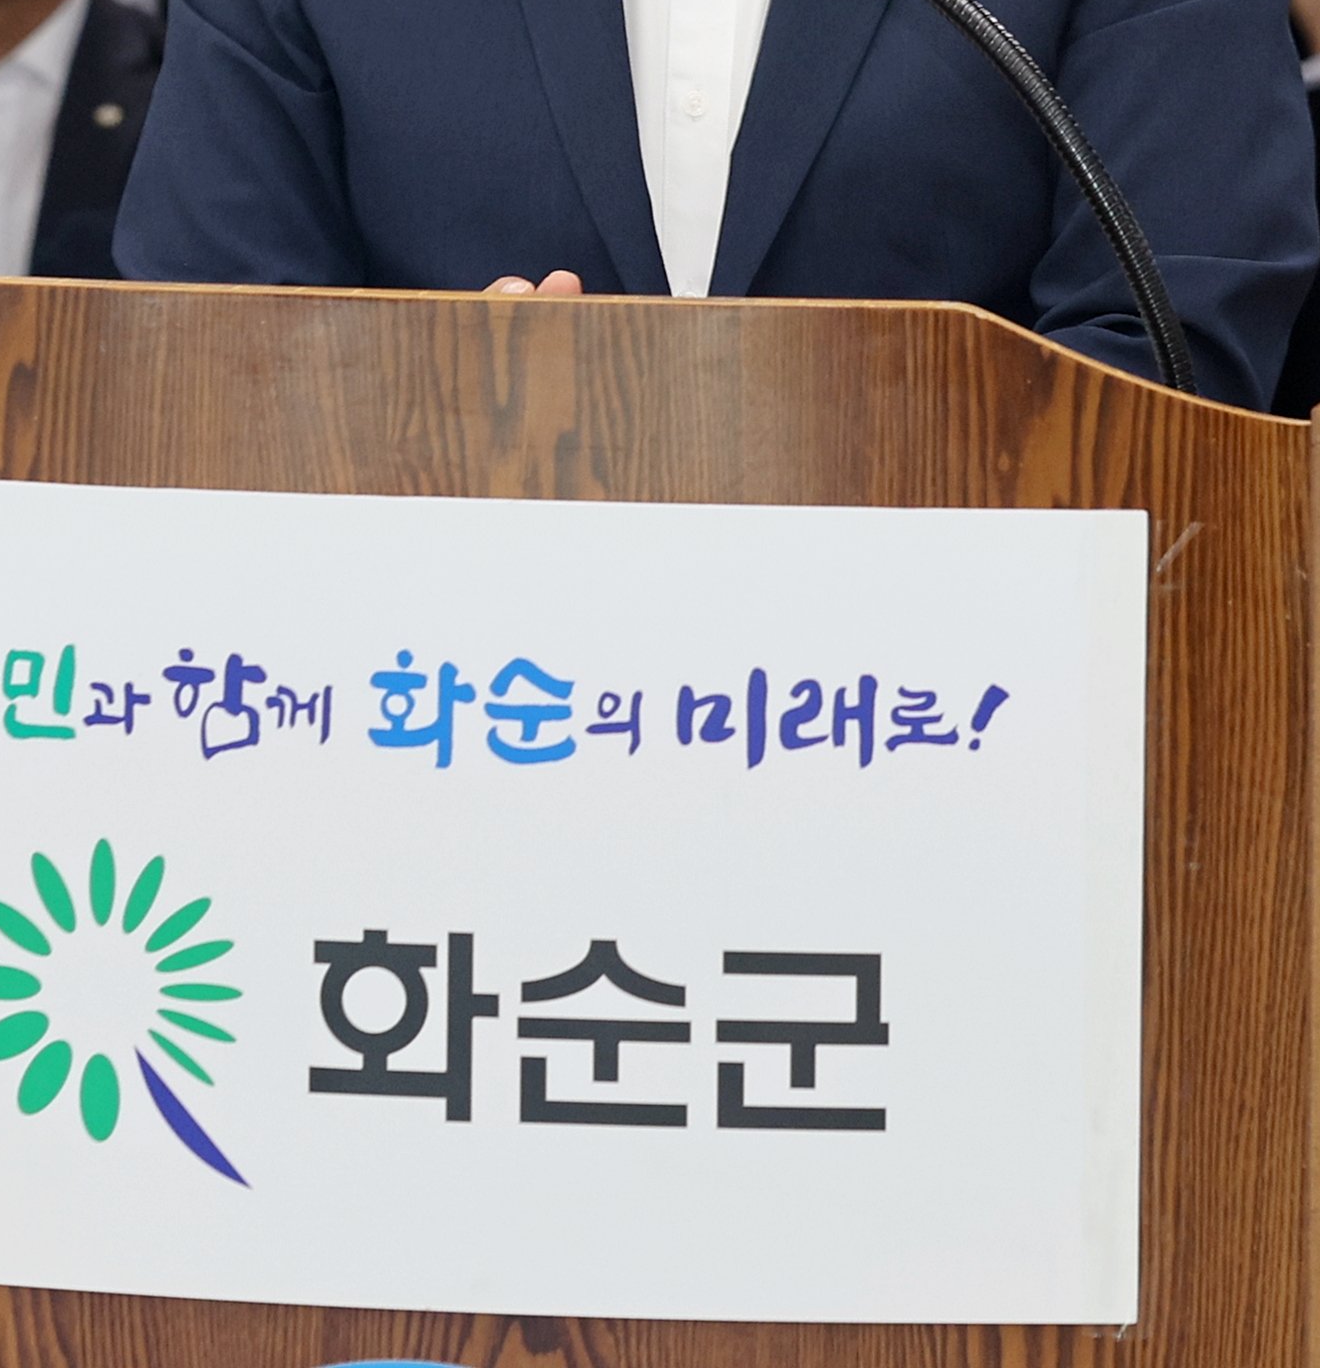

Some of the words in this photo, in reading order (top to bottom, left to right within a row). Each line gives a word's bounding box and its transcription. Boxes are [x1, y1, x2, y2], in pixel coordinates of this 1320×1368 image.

[160, 646, 334, 762] 함께
[366, 647, 645, 771] 화순의
[674, 666, 1011, 771] 미래로!
[307, 927, 891, 1133] 화순군
